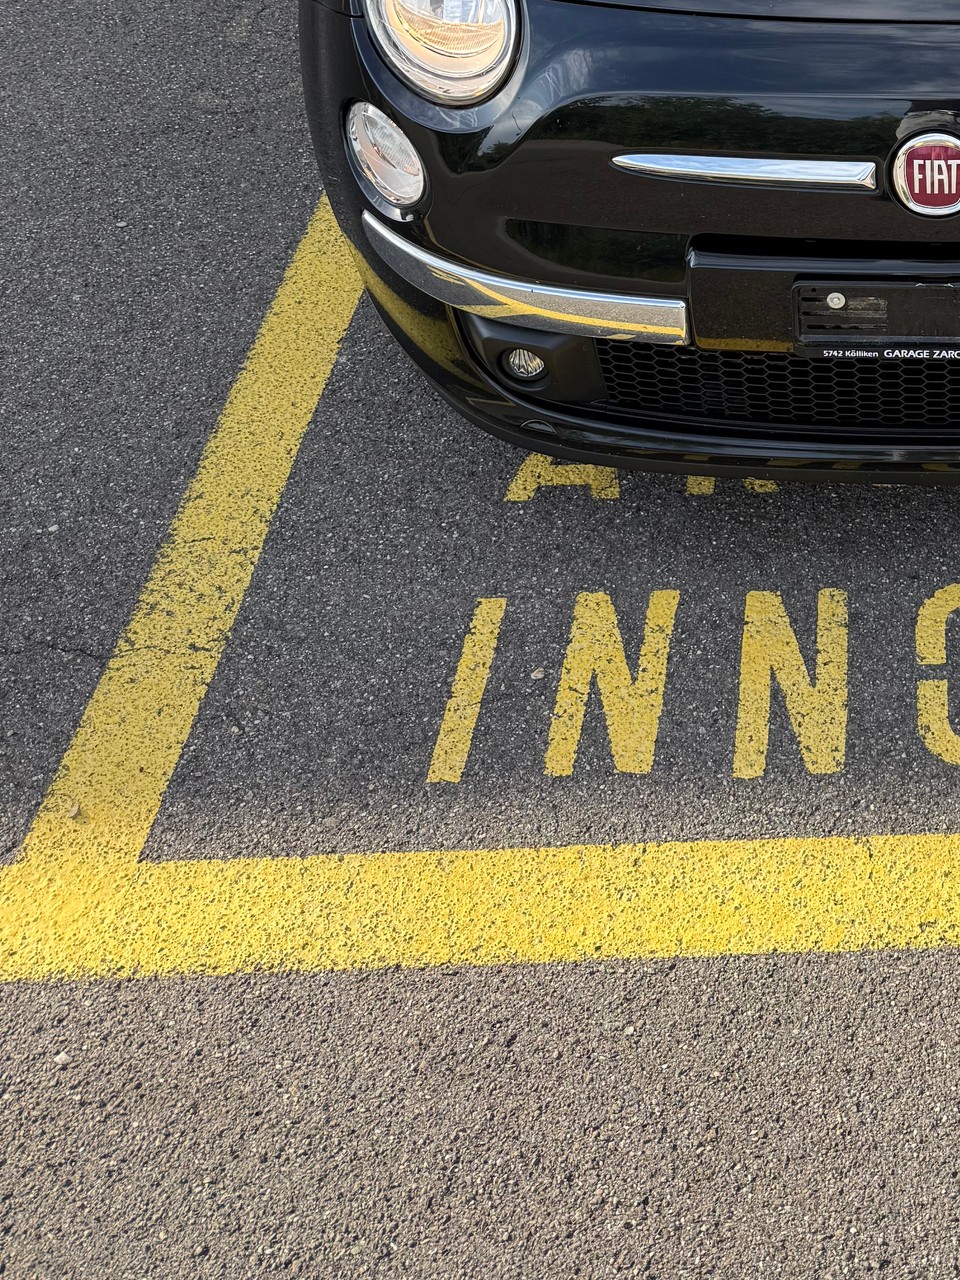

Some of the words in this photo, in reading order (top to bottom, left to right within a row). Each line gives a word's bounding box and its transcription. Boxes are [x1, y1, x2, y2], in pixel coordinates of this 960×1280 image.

[913, 159, 960, 194] FIAT
[845, 349, 879, 358] Kölliken
[883, 349, 930, 359] GARAGE
